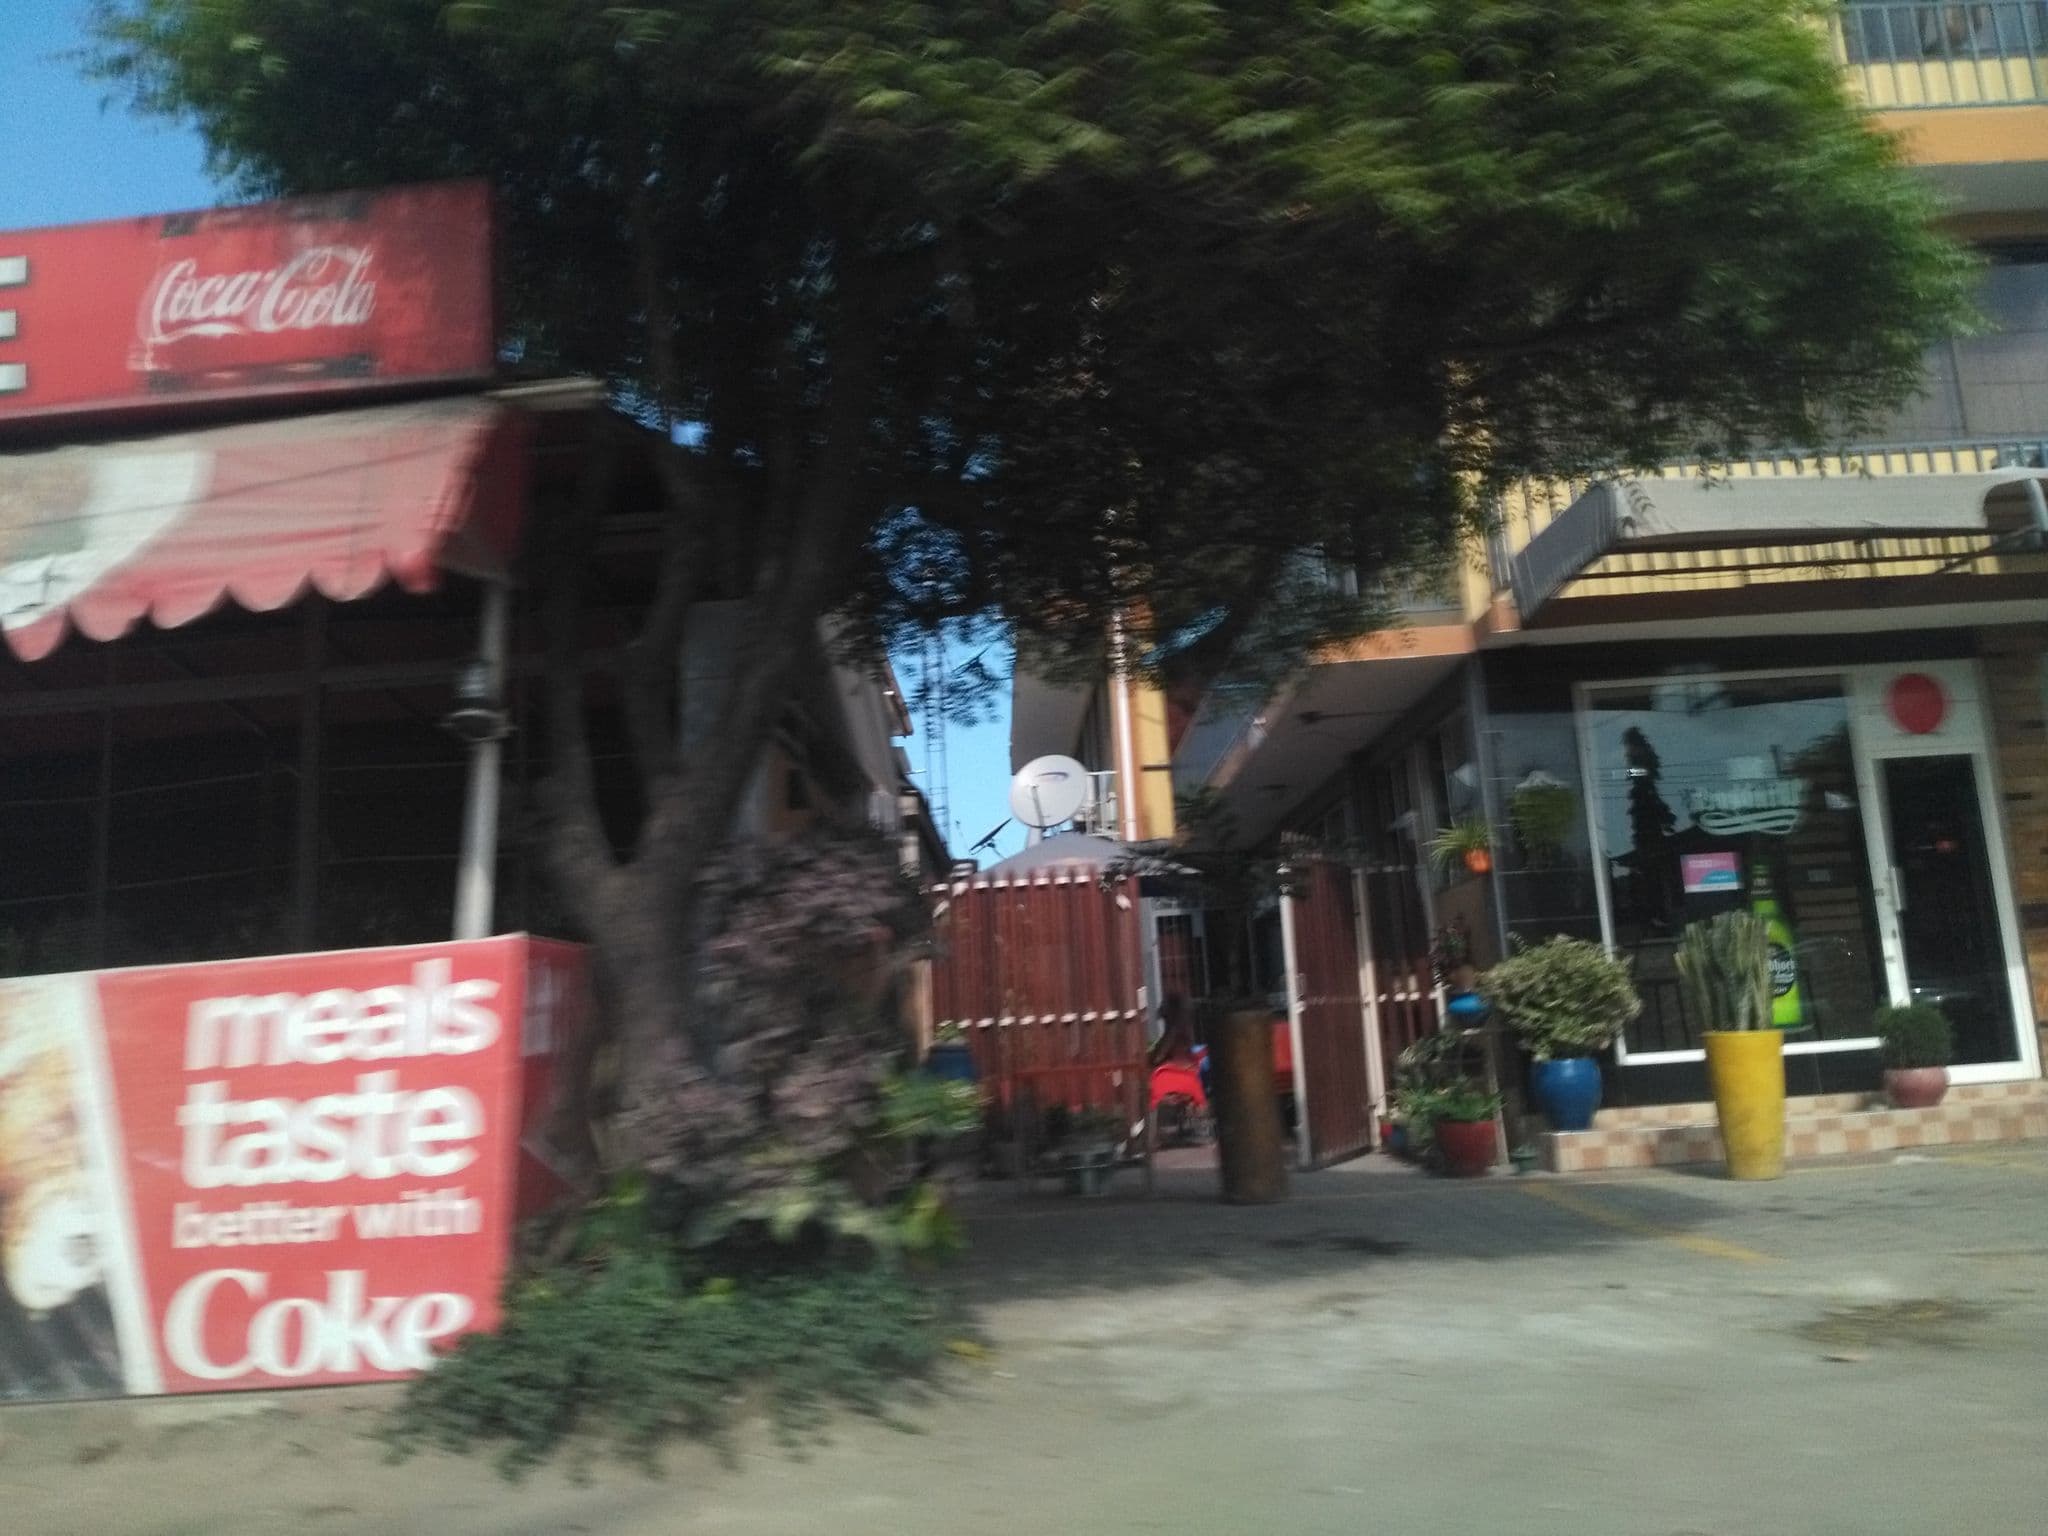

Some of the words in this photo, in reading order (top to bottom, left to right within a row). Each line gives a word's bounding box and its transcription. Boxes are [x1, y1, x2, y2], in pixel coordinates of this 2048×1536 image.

[184, 958, 501, 1071] meals
[176, 1070, 486, 1188] taste
[172, 1202, 348, 1248] better
[352, 1187, 482, 1240] with
[164, 1268, 475, 1380] Coke
